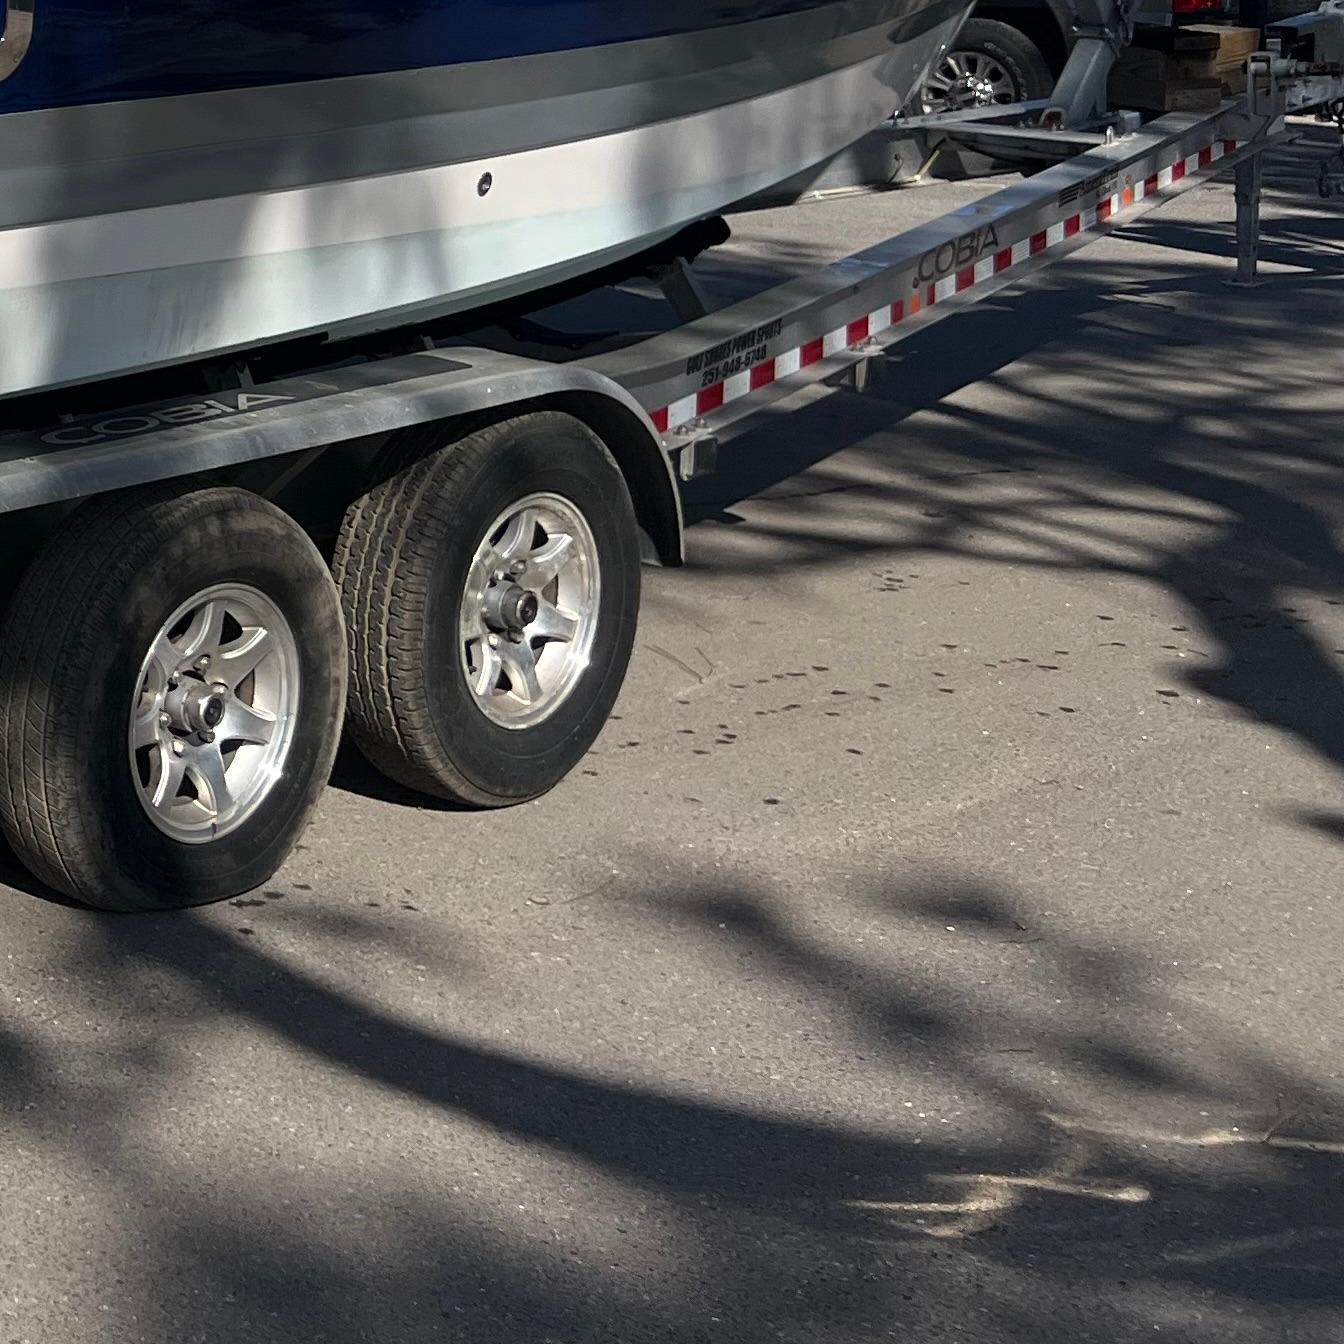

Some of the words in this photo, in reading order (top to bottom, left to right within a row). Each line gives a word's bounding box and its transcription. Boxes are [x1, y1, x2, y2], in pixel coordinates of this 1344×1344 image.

[918, 222, 1000, 282] COBIA
[733, 330, 756, 354] POWER
[757, 318, 783, 341] SPORTS
[40, 393, 297, 444] COBIA
